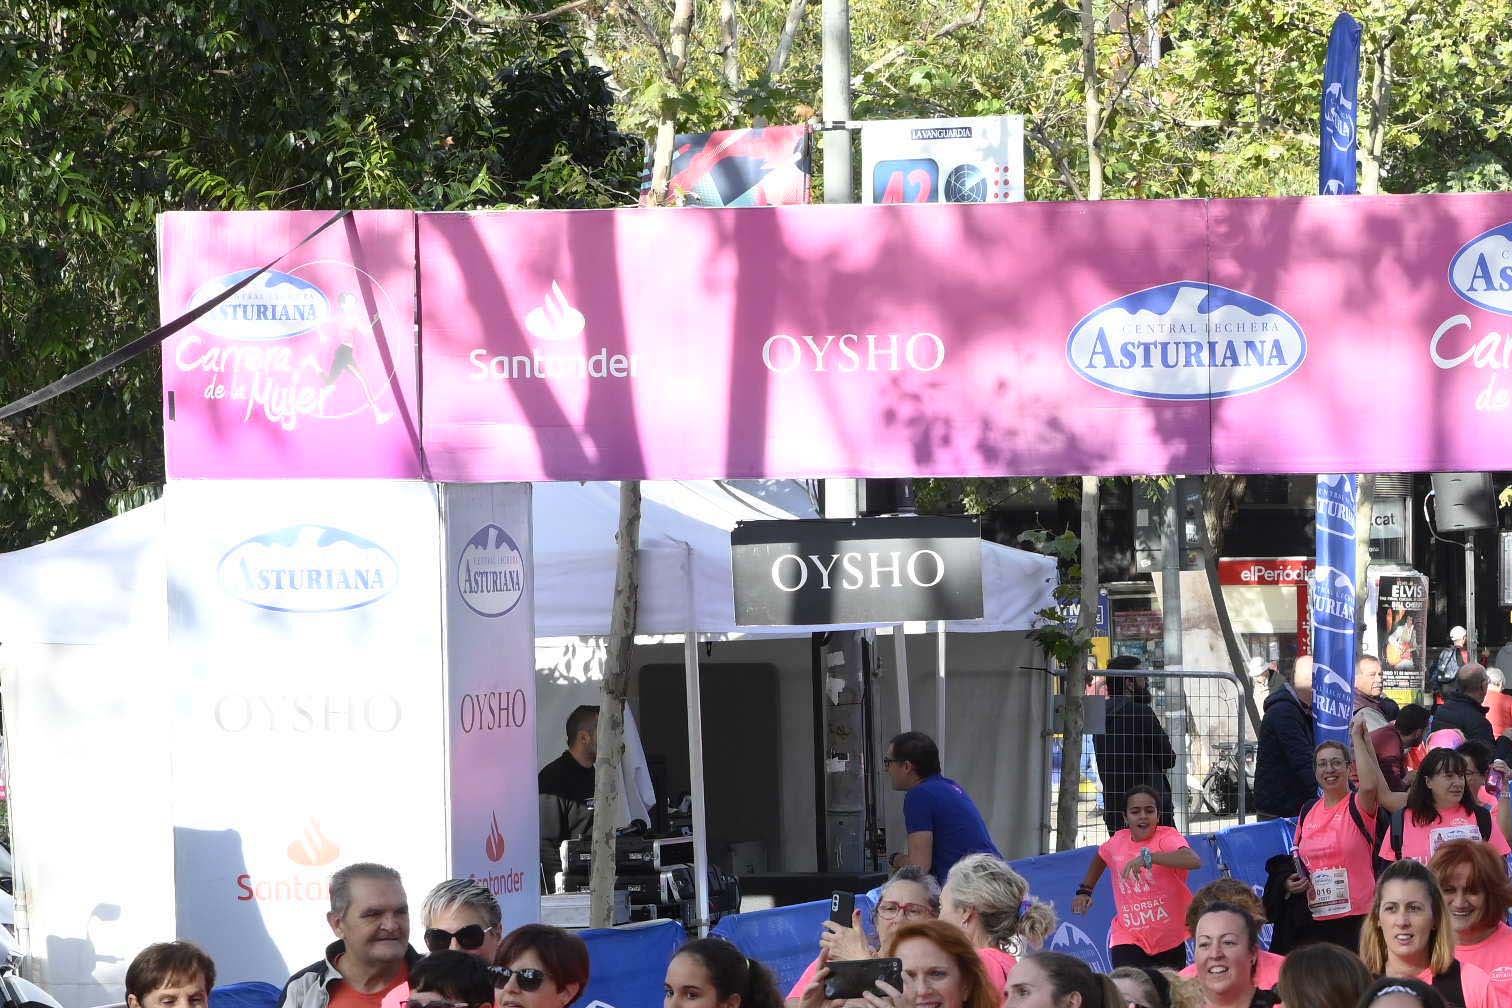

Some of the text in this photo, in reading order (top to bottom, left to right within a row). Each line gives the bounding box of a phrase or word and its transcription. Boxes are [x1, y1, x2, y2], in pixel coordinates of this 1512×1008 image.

[209, 302, 318, 321] STURIANA
[1122, 319, 1281, 336] CENTRAL LECHERA
[469, 348, 644, 381] Santander
[762, 332, 946, 373] OYSHO
[1084, 325, 1289, 370] ASTURIANA
[204, 373, 226, 401] de
[1474, 371, 1509, 412] de
[237, 556, 386, 591] ASTURIANA
[463, 559, 521, 595] ASTURIANA
[770, 548, 946, 593] OYSHO
[1392, 584, 1423, 598] ELVIS
[214, 692, 403, 735] OYSHO
[460, 688, 527, 735] OYSHO
